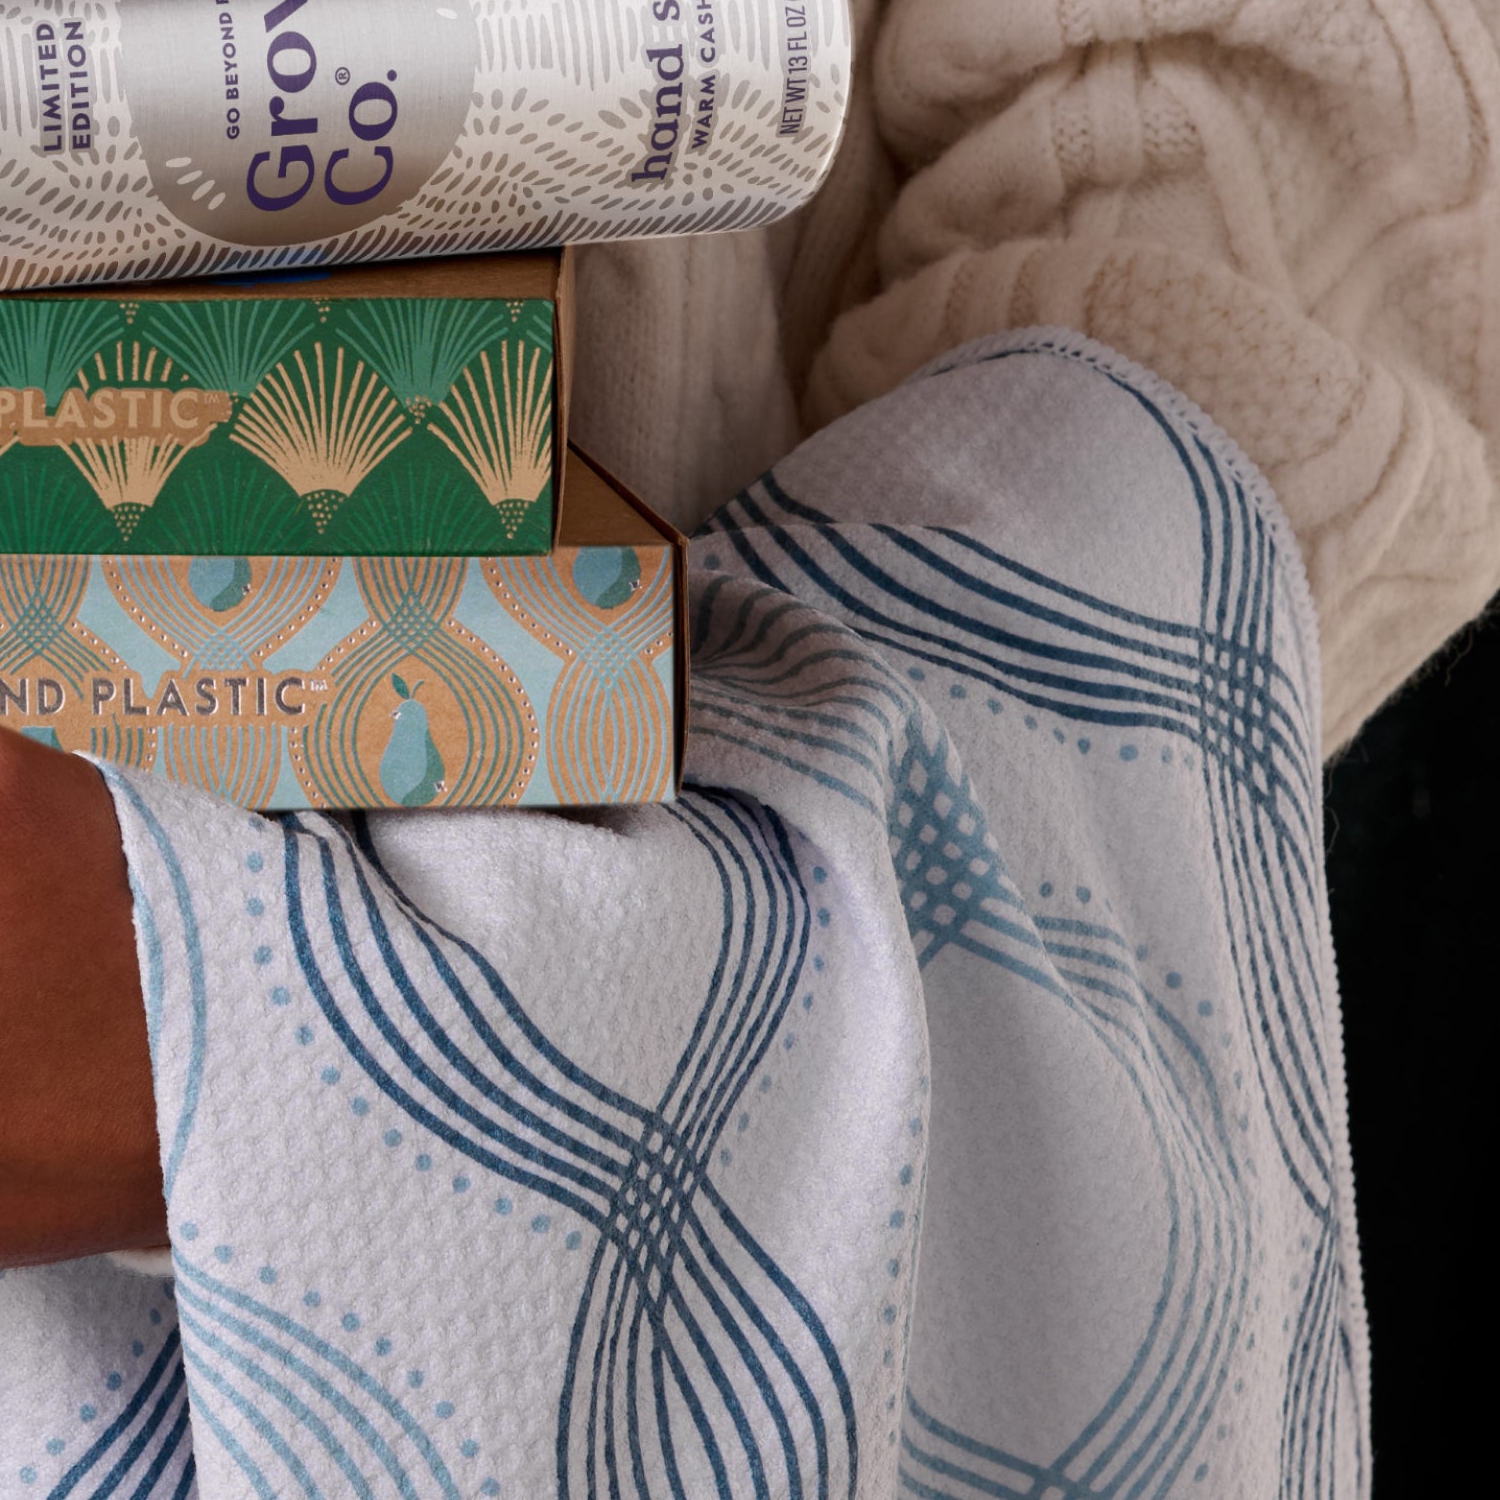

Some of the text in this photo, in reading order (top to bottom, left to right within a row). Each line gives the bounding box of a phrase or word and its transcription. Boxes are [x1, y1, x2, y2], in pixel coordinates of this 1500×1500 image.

[784, 5, 807, 28] OZ
[219, 11, 240, 100] BEYOND
[787, 31, 808, 51] FL
[788, 57, 808, 75] 13
[36, 22, 63, 152] LIMITED
[63, 20, 91, 150] EDITION
[786, 77, 808, 103] WT
[226, 107, 241, 140] GO
[631, 43, 685, 183] hand
[692, 74, 717, 149] WARM
[780, 107, 803, 135] NET
